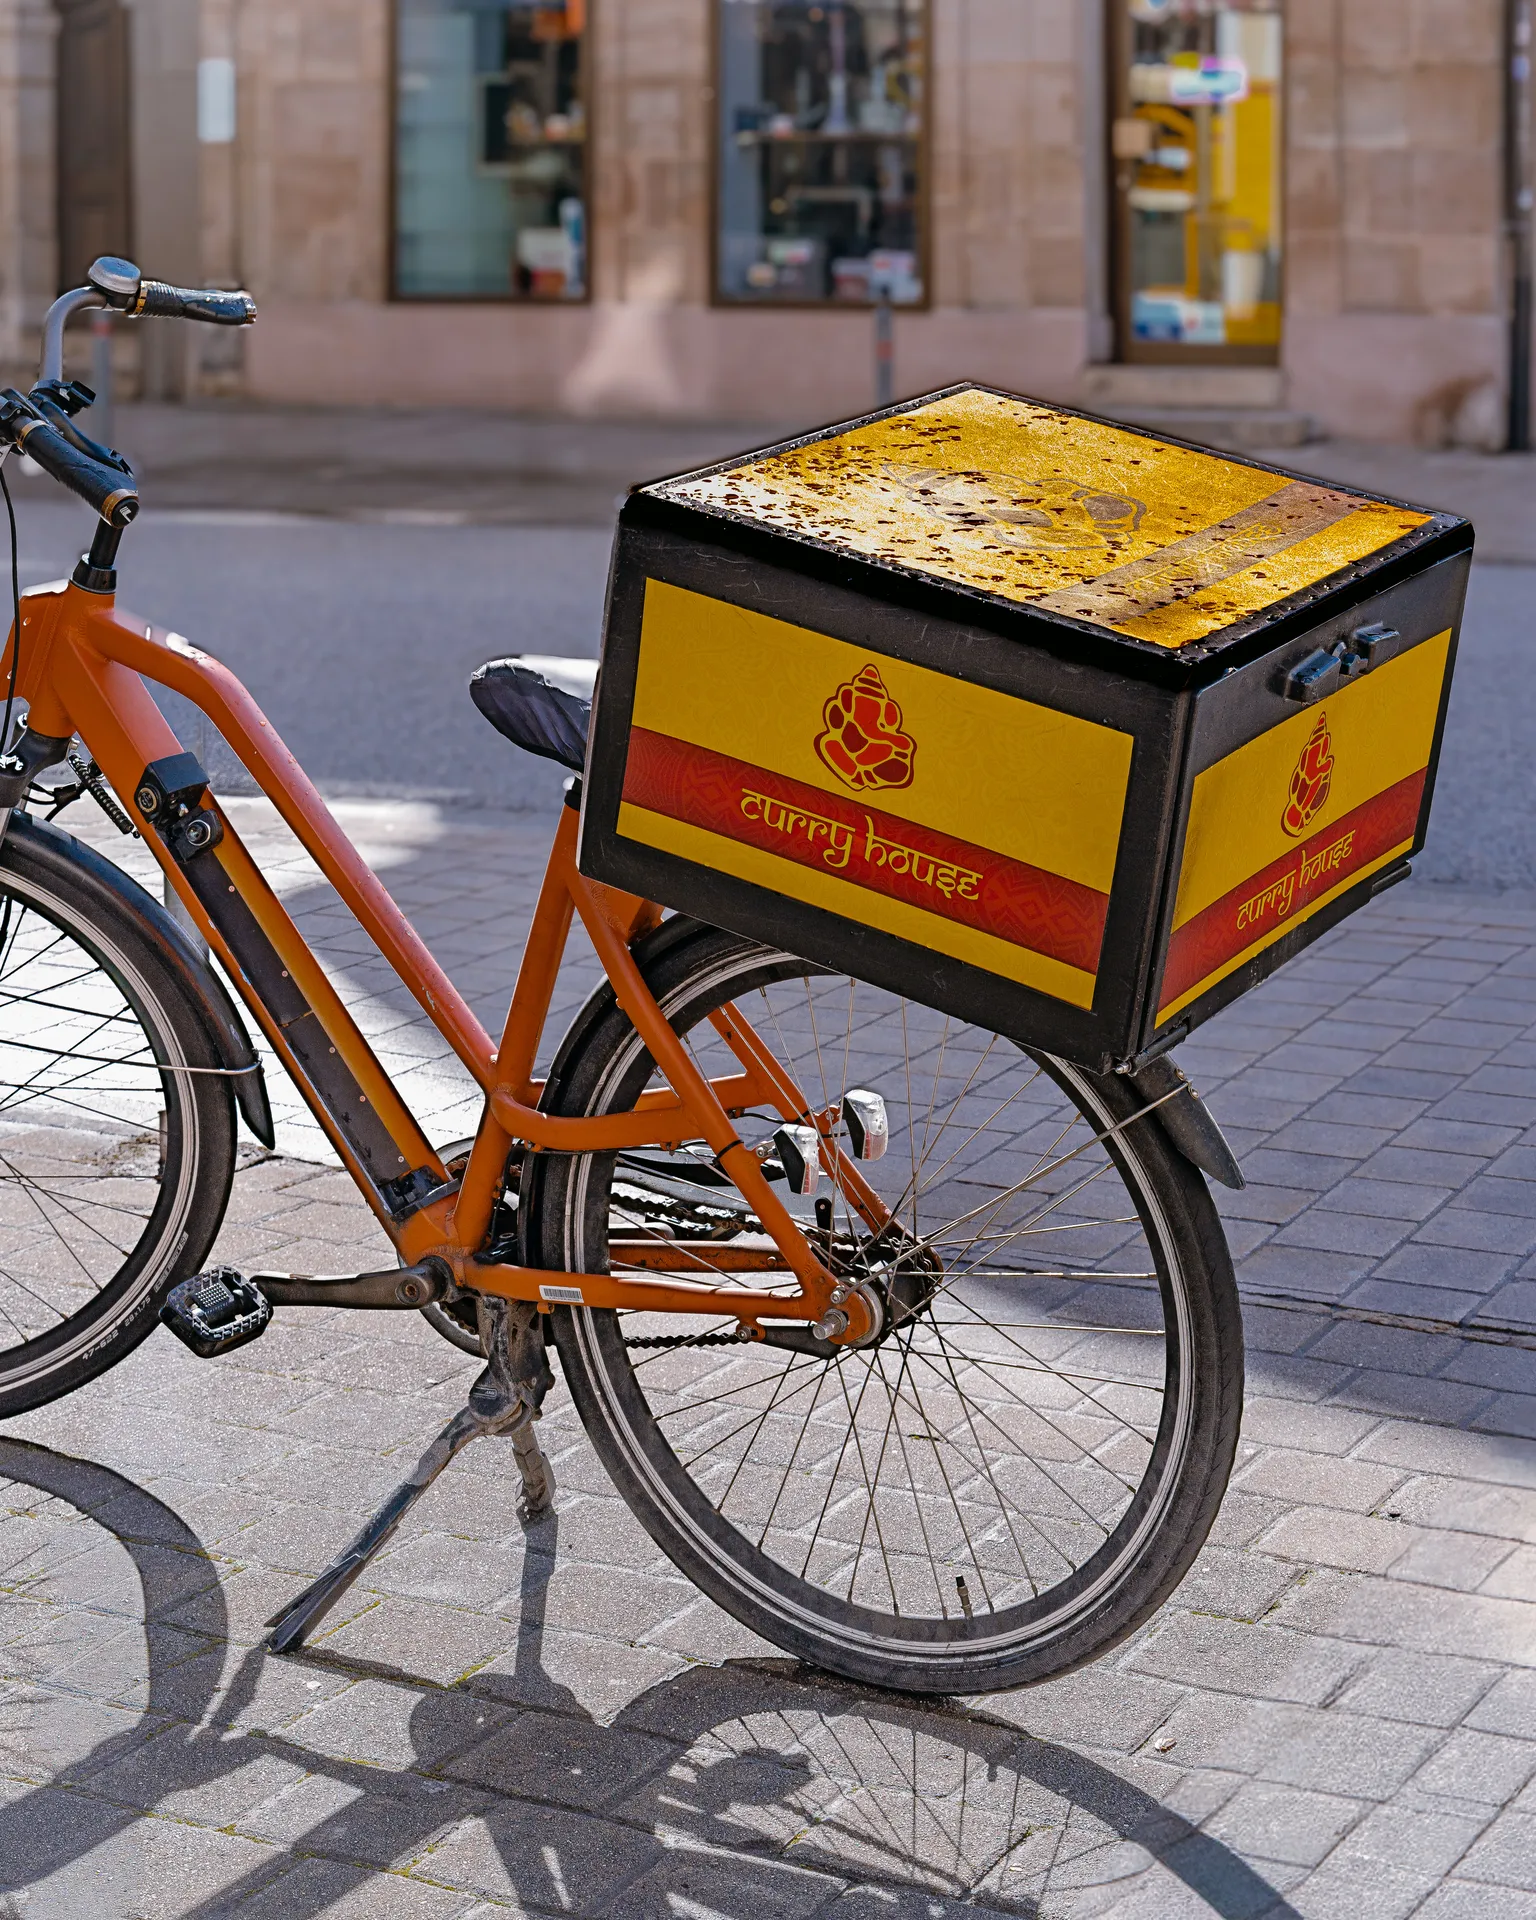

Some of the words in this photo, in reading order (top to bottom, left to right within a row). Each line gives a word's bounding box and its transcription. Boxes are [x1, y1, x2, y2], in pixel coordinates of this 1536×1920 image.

[740, 788, 855, 868] curry
[865, 815, 983, 900] house
[1237, 870, 1296, 930] curry
[1299, 830, 1356, 889] house
